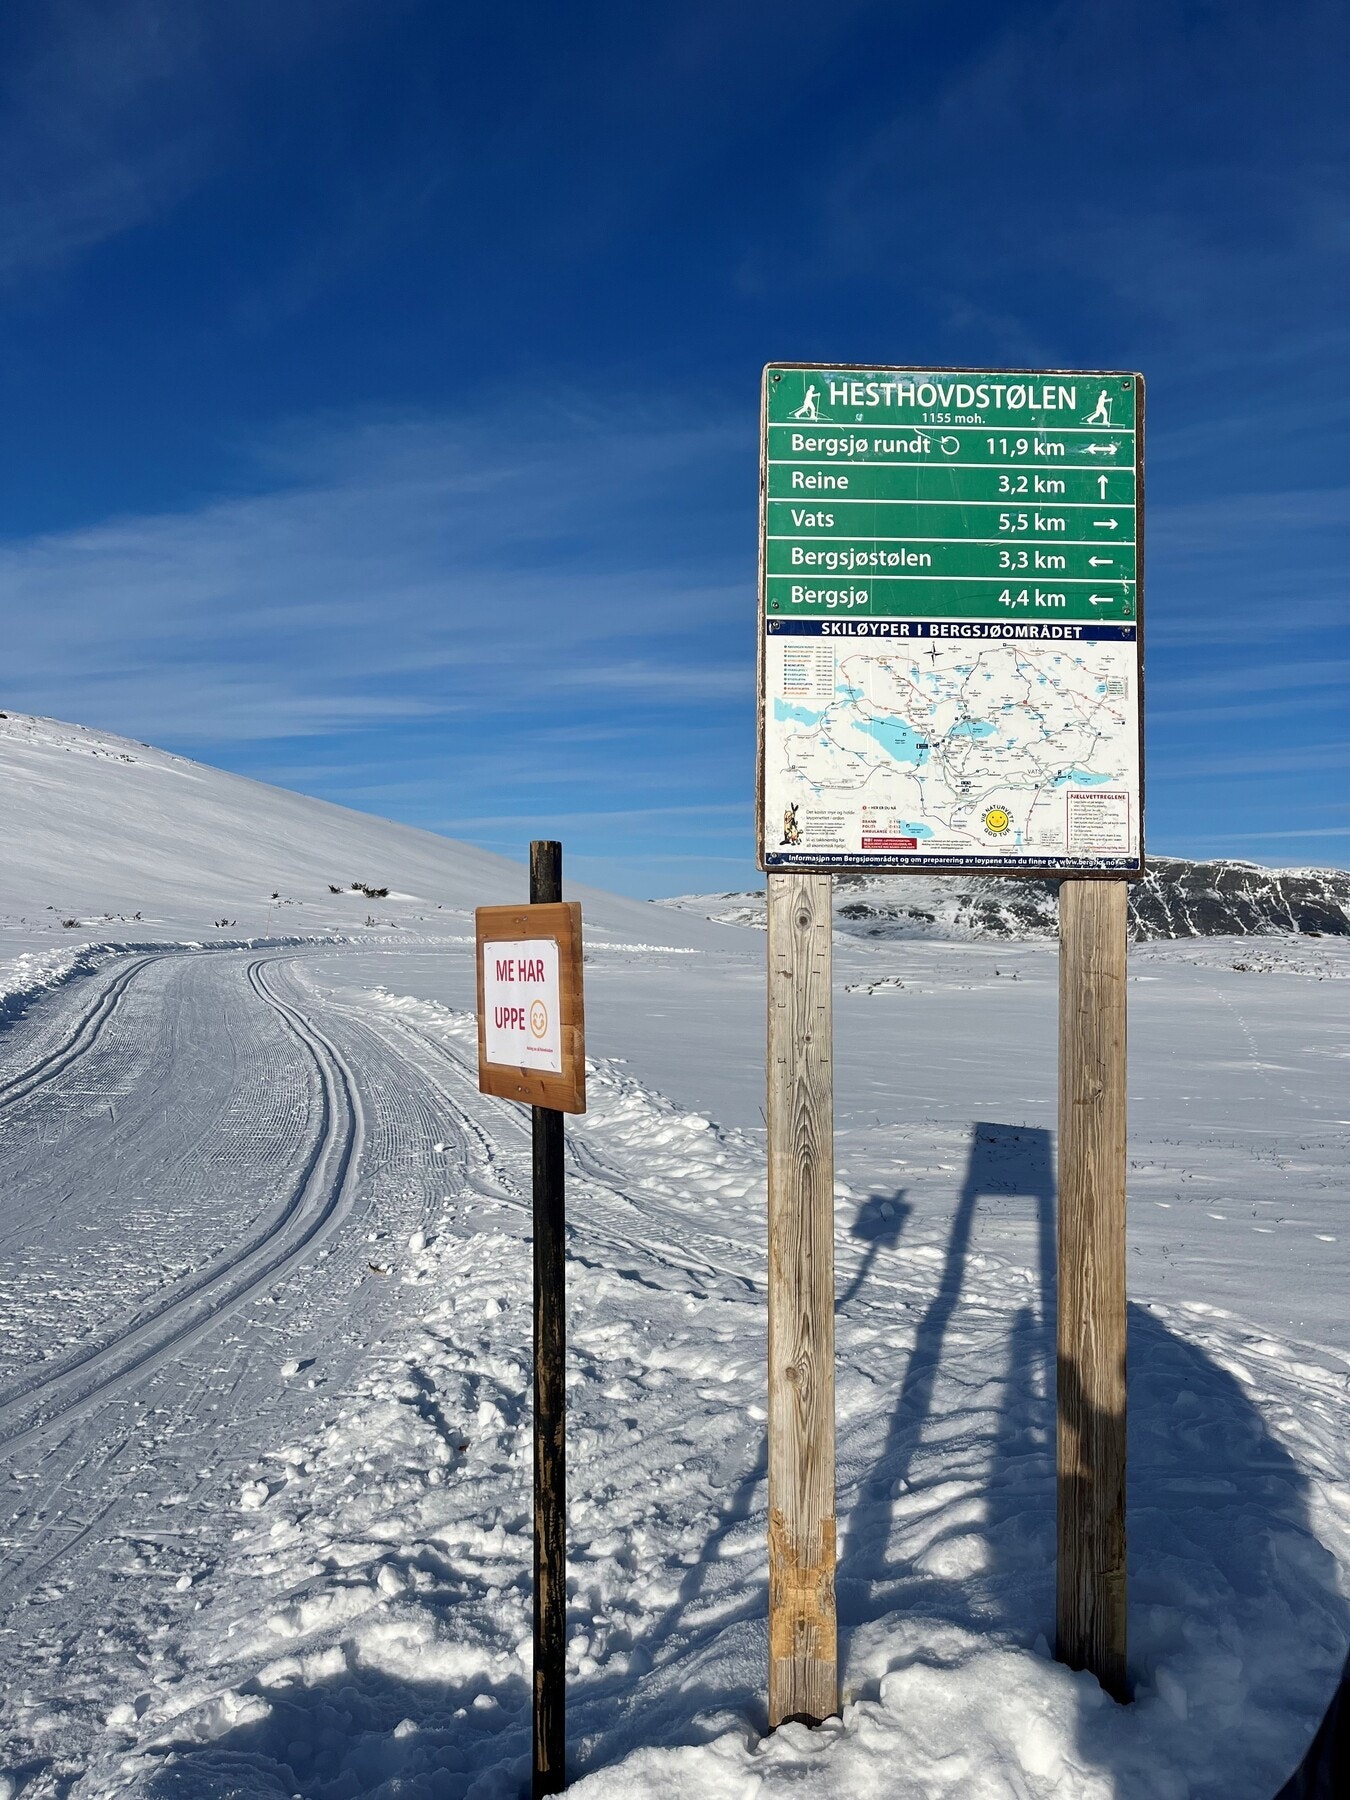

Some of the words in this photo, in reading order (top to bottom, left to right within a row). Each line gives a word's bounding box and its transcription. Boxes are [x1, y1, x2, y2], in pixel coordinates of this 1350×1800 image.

[830, 381, 1076, 410] HESTHOVDSTØLEN
[922, 412, 951, 423] 1155
[954, 413, 986, 424] moh.
[791, 433, 868, 456] Bergsjø
[874, 435, 931, 453] rundt
[987, 438, 1028, 457] 11,9
[1034, 437, 1065, 456] km
[791, 471, 849, 489] Reine
[998, 475, 1028, 495] 3,2
[1034, 475, 1066, 494] km
[791, 509, 835, 527] Vats
[998, 513, 1029, 533] 5,5
[1034, 513, 1066, 531] km
[791, 547, 932, 570] Bergsjøstølen
[998, 551, 1029, 571] 3,3
[1034, 551, 1066, 569] km
[791, 585, 869, 608] Bergsjø
[998, 589, 1029, 609] 4,4
[1034, 589, 1067, 607] km
[821, 622, 910, 636] SKILØYPER
[917, 624, 923, 636] I
[929, 624, 1083, 639] BERGSJØOMRÅDET
[843, 855, 899, 864] Bergsjøområdet
[922, 856, 964, 865] preparering
[974, 857, 1002, 866] løypene
[496, 959, 515, 982] ME
[518, 959, 545, 982] HAR
[495, 1006, 526, 1030] UPPE
